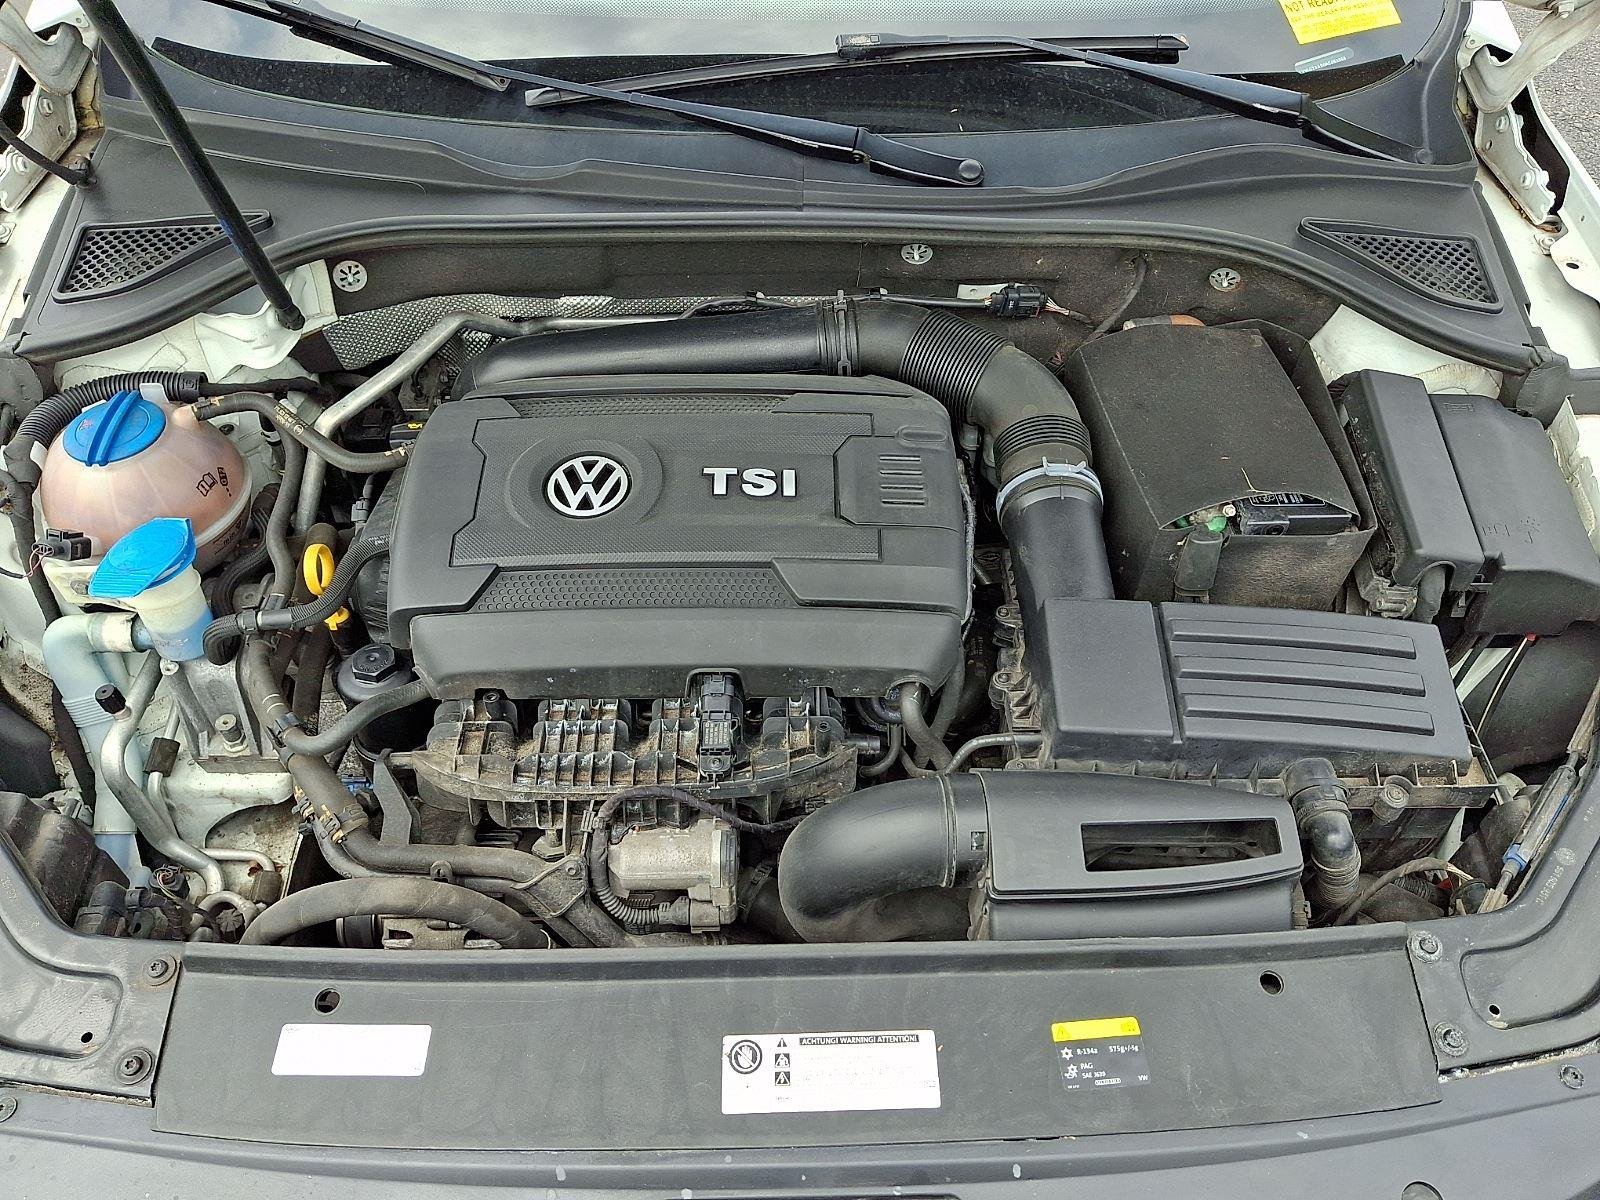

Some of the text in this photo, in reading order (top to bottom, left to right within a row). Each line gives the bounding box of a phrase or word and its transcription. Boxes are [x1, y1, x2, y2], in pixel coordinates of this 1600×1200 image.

[1285, 1, 1304, 12] NOT
[702, 467, 797, 498] TSI
[801, 1034, 918, 1045] ACHTUNG! WARNING! ATTENTION!
